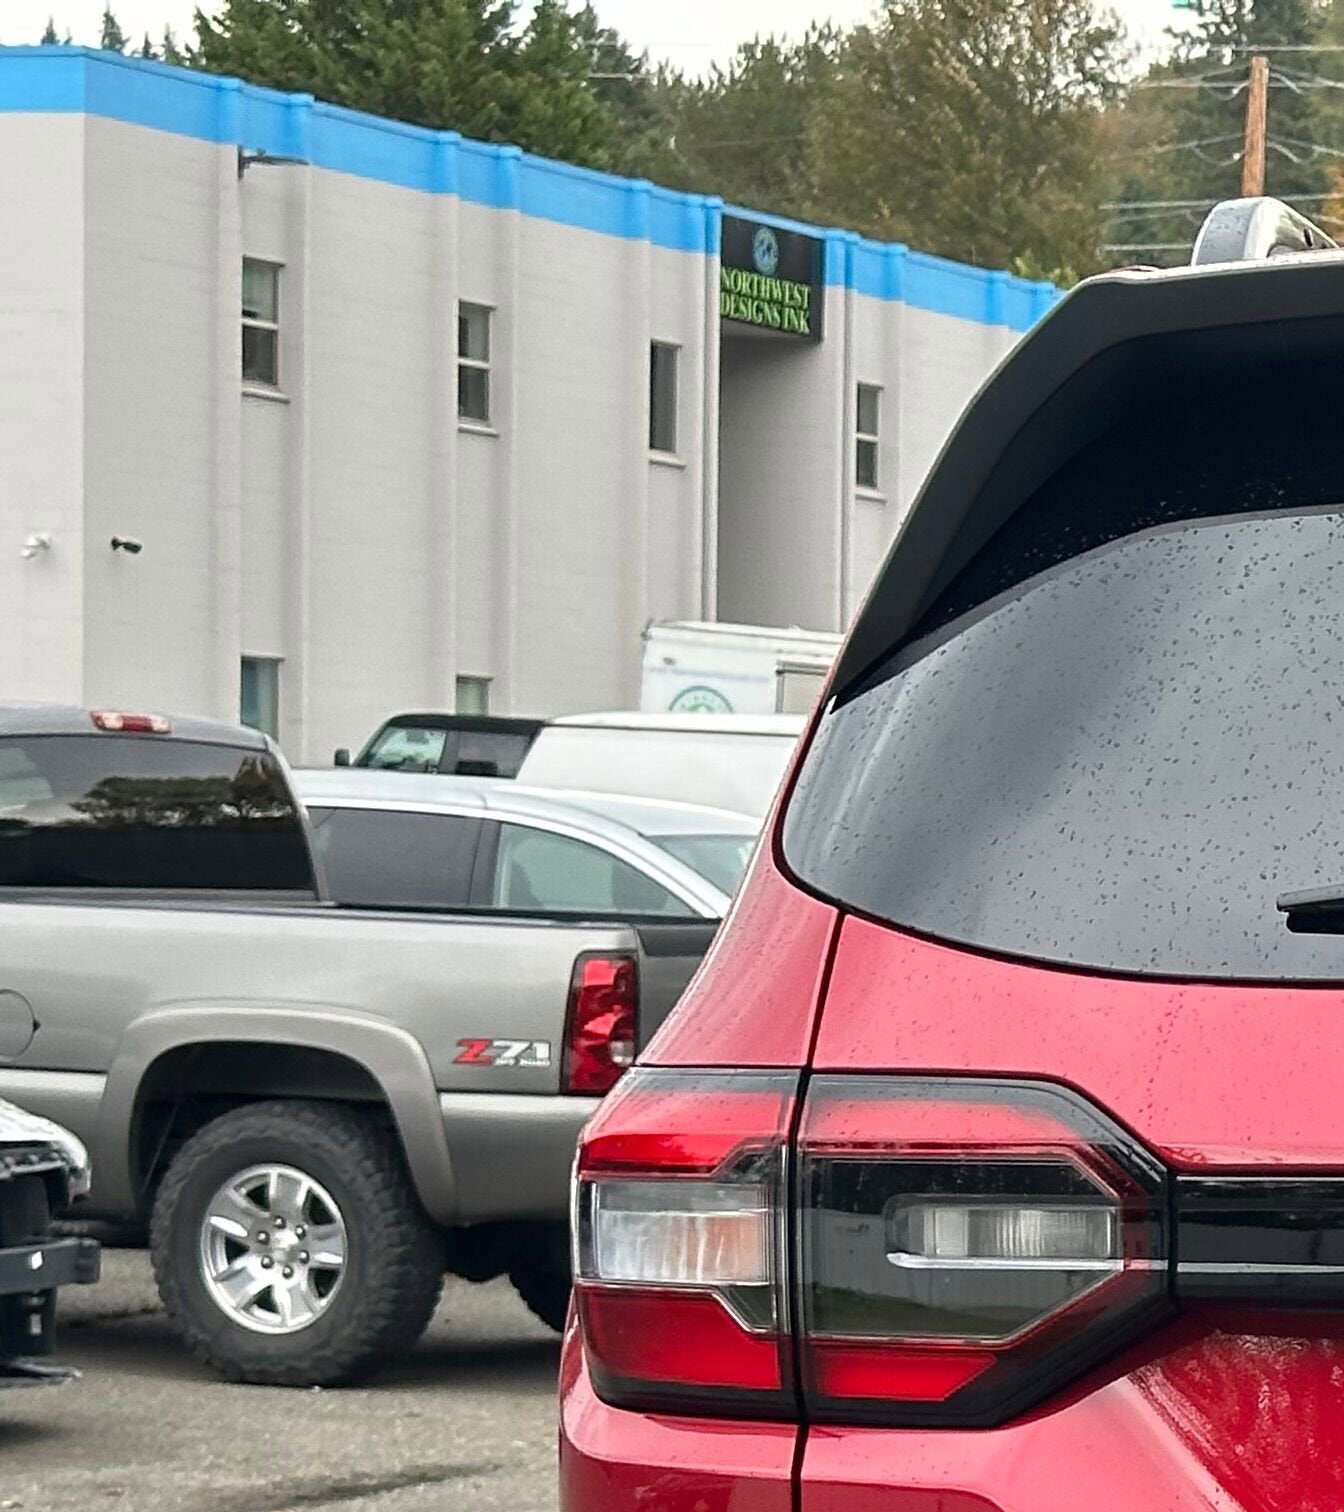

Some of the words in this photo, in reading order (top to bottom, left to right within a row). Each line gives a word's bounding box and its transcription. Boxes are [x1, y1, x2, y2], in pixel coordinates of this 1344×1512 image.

[719, 266, 811, 309] NORTHWEST
[719, 291, 782, 328] DESIGNS
[783, 307, 810, 335] INK
[453, 1039, 551, 1065] Z71
